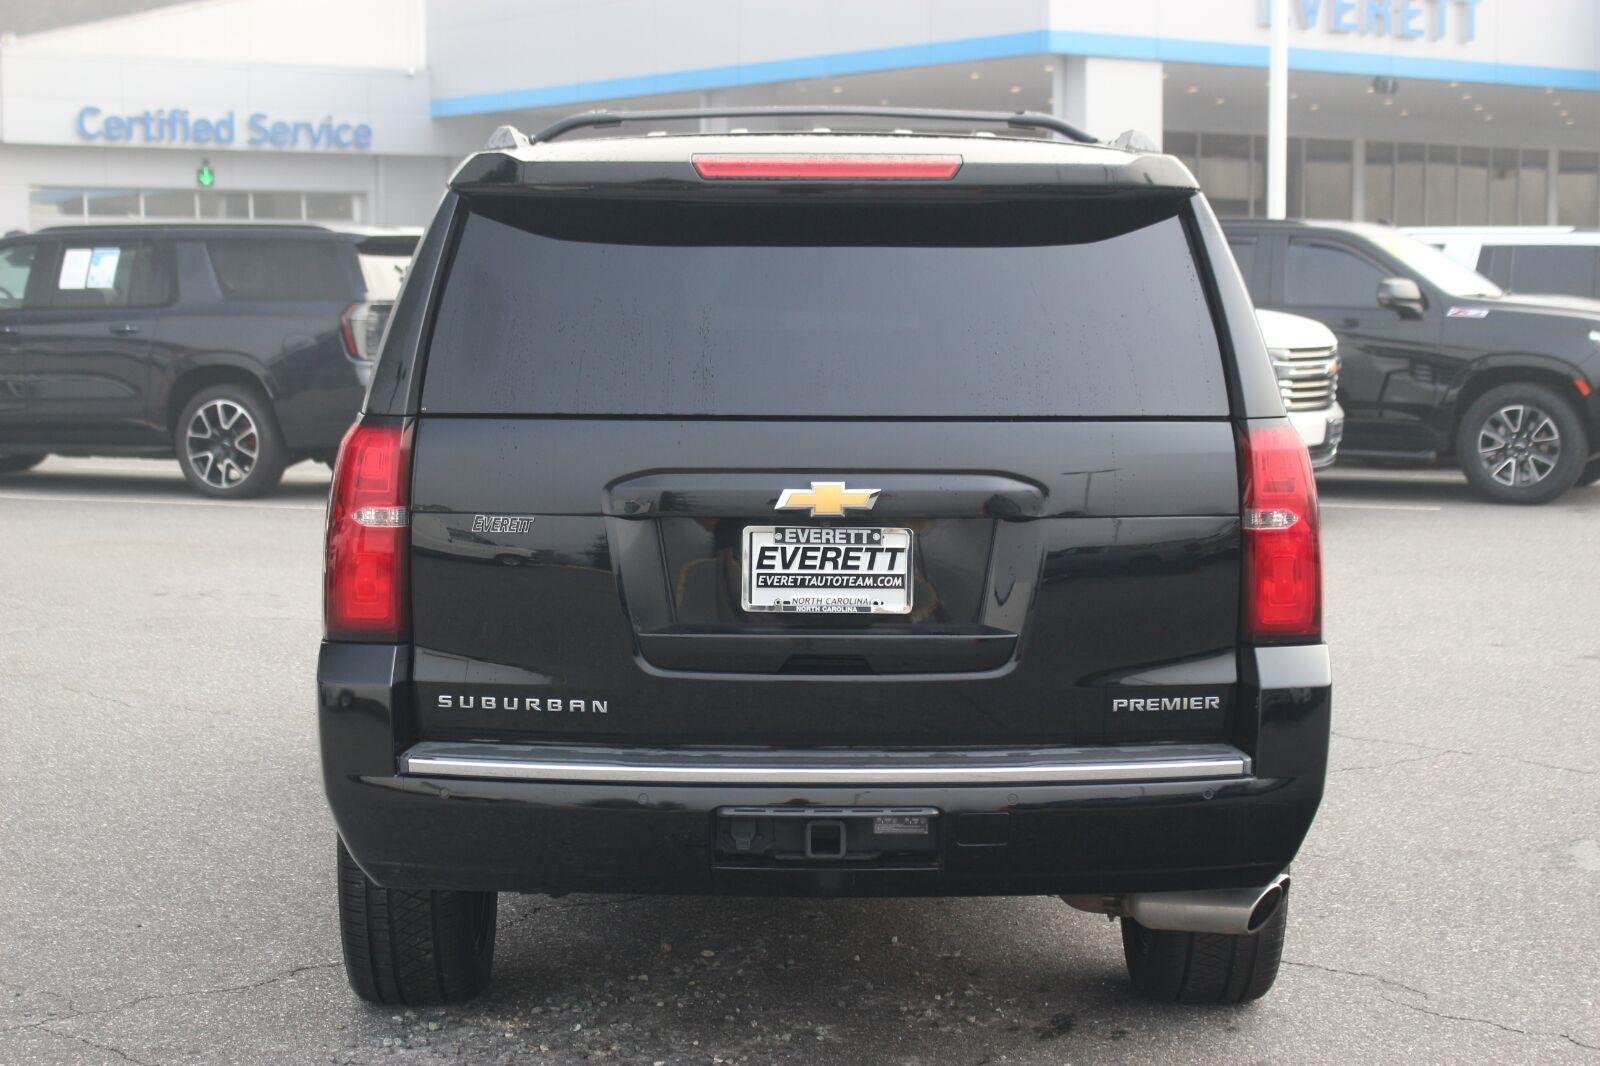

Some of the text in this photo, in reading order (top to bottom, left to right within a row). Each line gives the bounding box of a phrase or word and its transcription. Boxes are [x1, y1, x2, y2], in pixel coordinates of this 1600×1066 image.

[1256, 0, 1479, 44] VERETT
[76, 105, 373, 149] Certified Service
[471, 514, 535, 533] EVERETT
[785, 529, 871, 543] EVERETT
[756, 546, 905, 571] EVERETT
[758, 576, 902, 587] EVERETTAUTOTEAM.COM
[792, 597, 868, 606] NORTH CAROLINA
[438, 695, 608, 713] SUBURBAN
[1112, 696, 1220, 712] PREMIER
